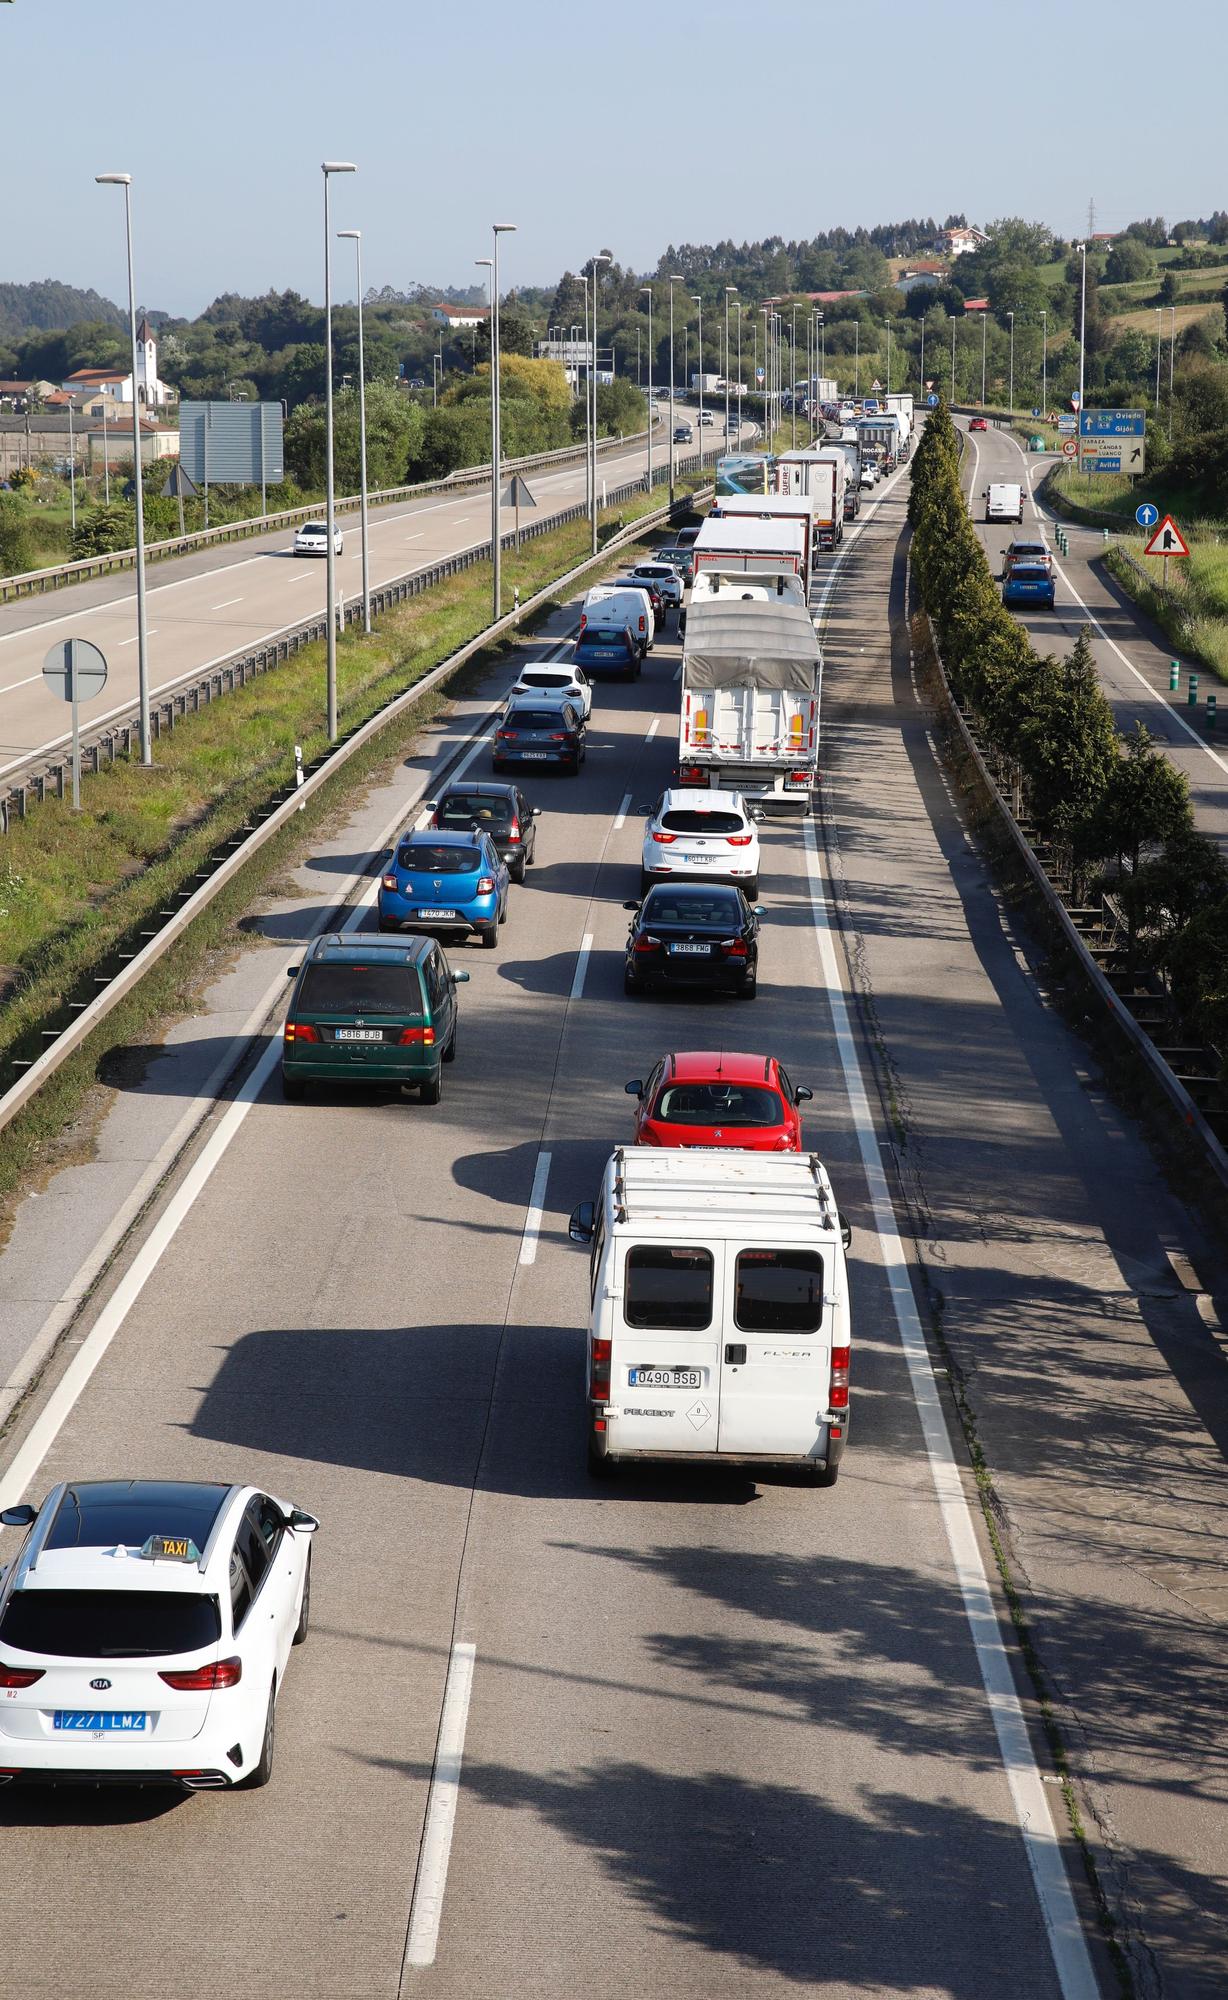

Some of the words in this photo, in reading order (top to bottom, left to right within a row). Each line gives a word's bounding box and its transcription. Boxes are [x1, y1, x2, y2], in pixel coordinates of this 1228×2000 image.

[1115, 425, 1134, 433] Gijón
[341, 1030, 361, 1038] 5816
[638, 1371, 670, 1384] 0490
[674, 1373, 697, 1385] BSB
[623, 1408, 676, 1417] PEUGEOT
[163, 1540, 187, 1556] TAXI
[93, 1680, 109, 1688] KIA
[62, 1712, 104, 1729] 7271
[111, 1713, 144, 1729] LMZ
